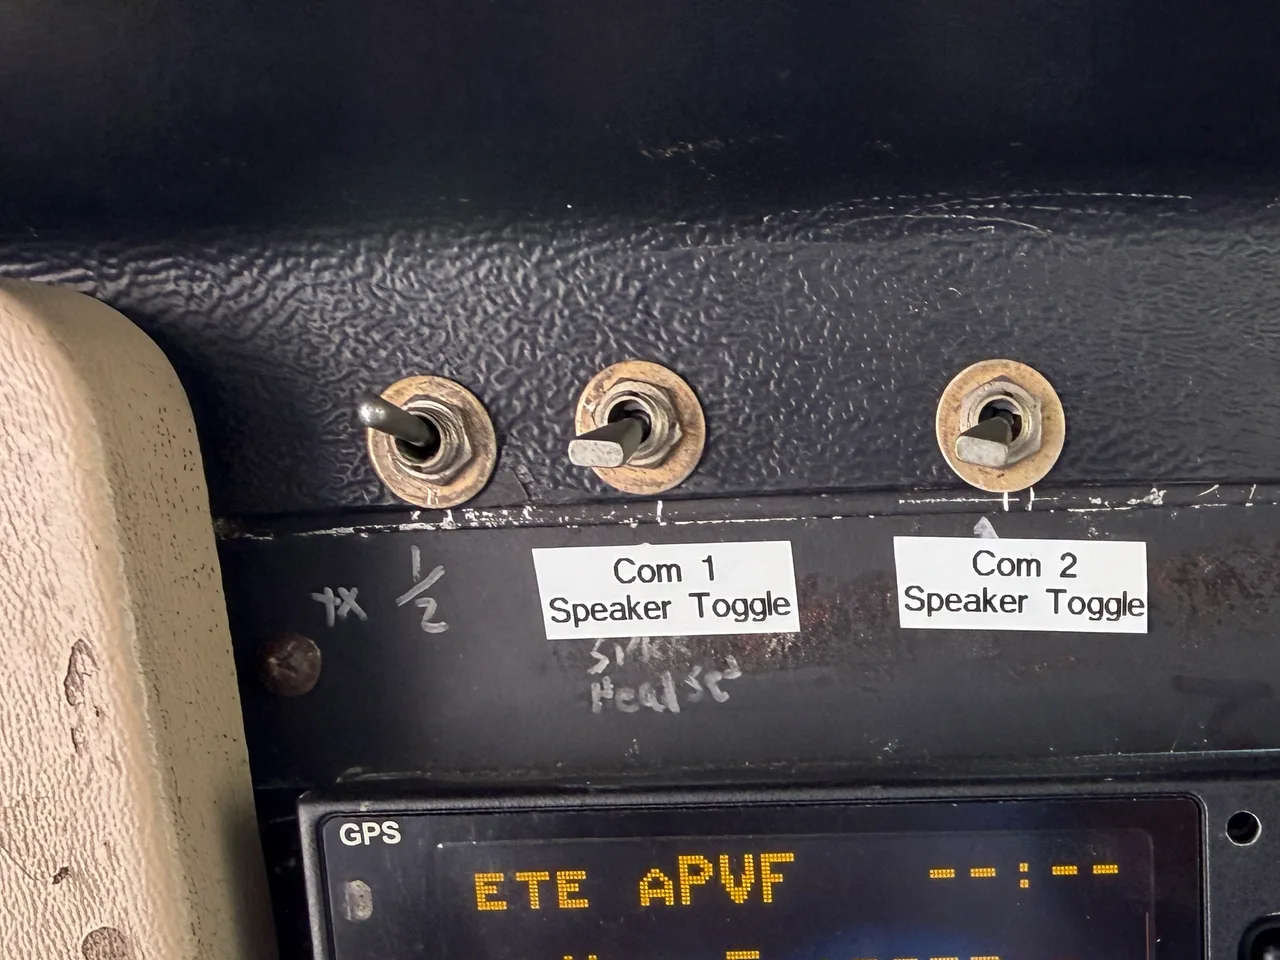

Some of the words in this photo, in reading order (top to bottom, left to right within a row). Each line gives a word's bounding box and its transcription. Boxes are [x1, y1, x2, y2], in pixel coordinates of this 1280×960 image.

[613, 556, 683, 584] Com
[703, 554, 716, 582] 1
[971, 550, 1041, 578] Com
[1060, 551, 1078, 578] 2
[549, 596, 672, 625] Speaker
[688, 591, 791, 622] Toggle
[904, 585, 1028, 617] Speaker
[1045, 588, 1145, 620] Toggle
[339, 821, 401, 847] GPS
[474, 871, 590, 911] ETE
